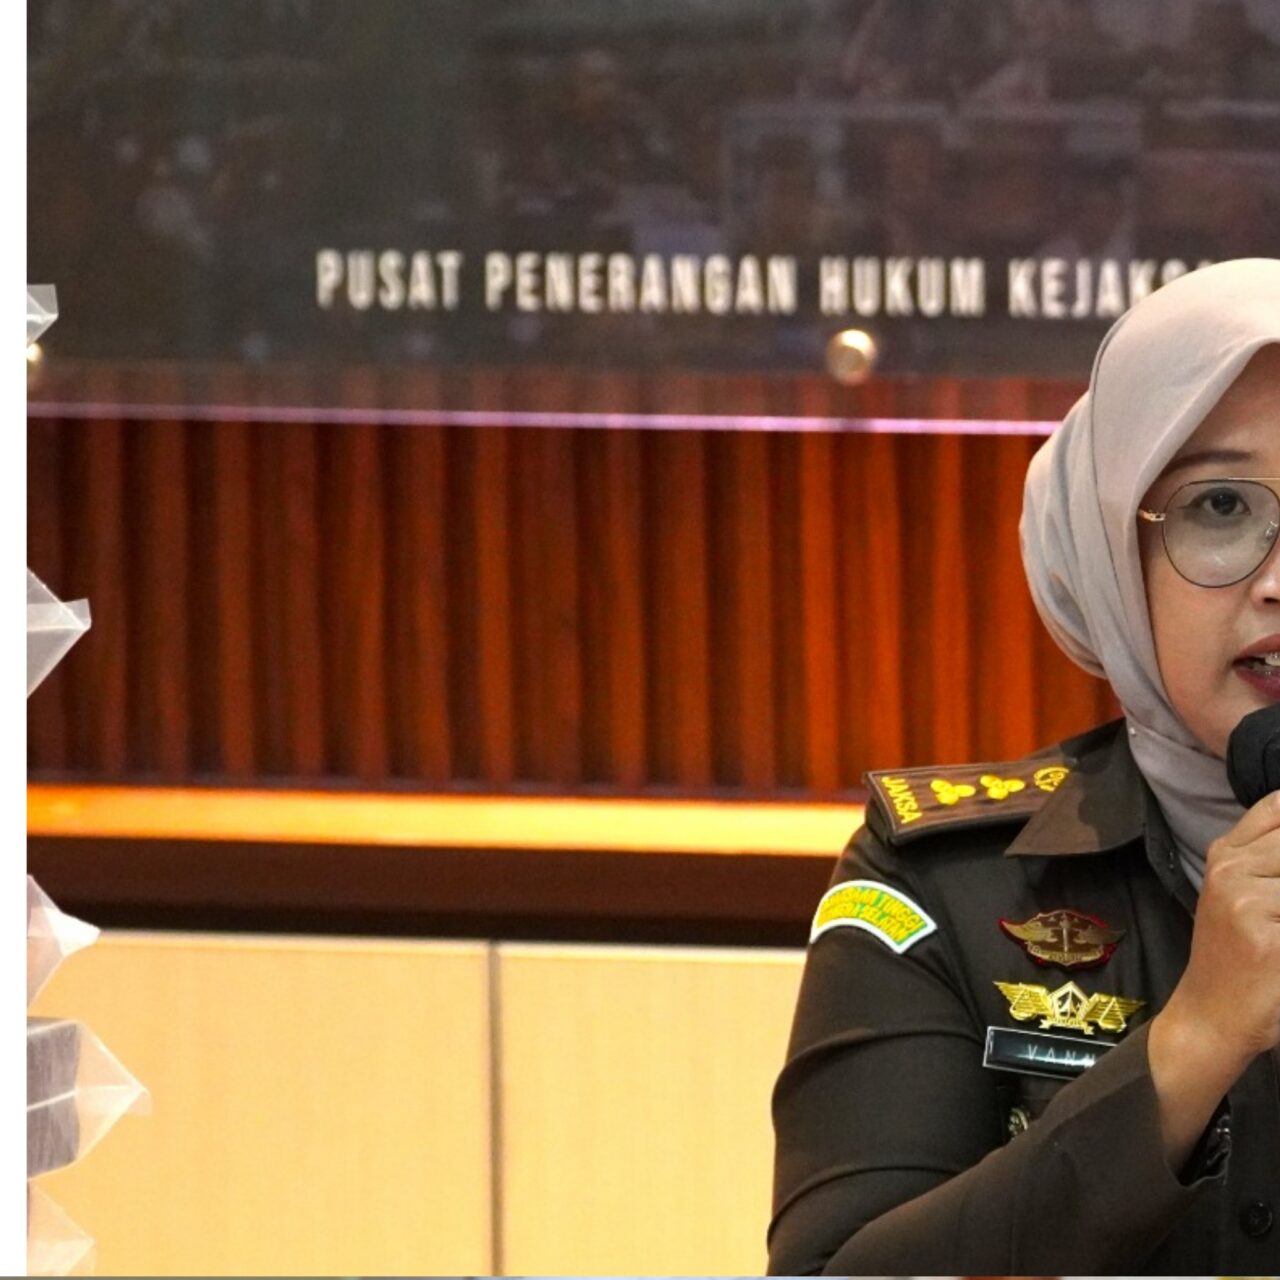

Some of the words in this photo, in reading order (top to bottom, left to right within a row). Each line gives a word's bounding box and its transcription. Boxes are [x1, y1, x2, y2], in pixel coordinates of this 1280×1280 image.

[316, 248, 463, 311] PUSAT
[484, 250, 797, 315] PENERANGAN
[818, 254, 986, 317] HUKUM
[881, 776, 923, 824] JAKSA
